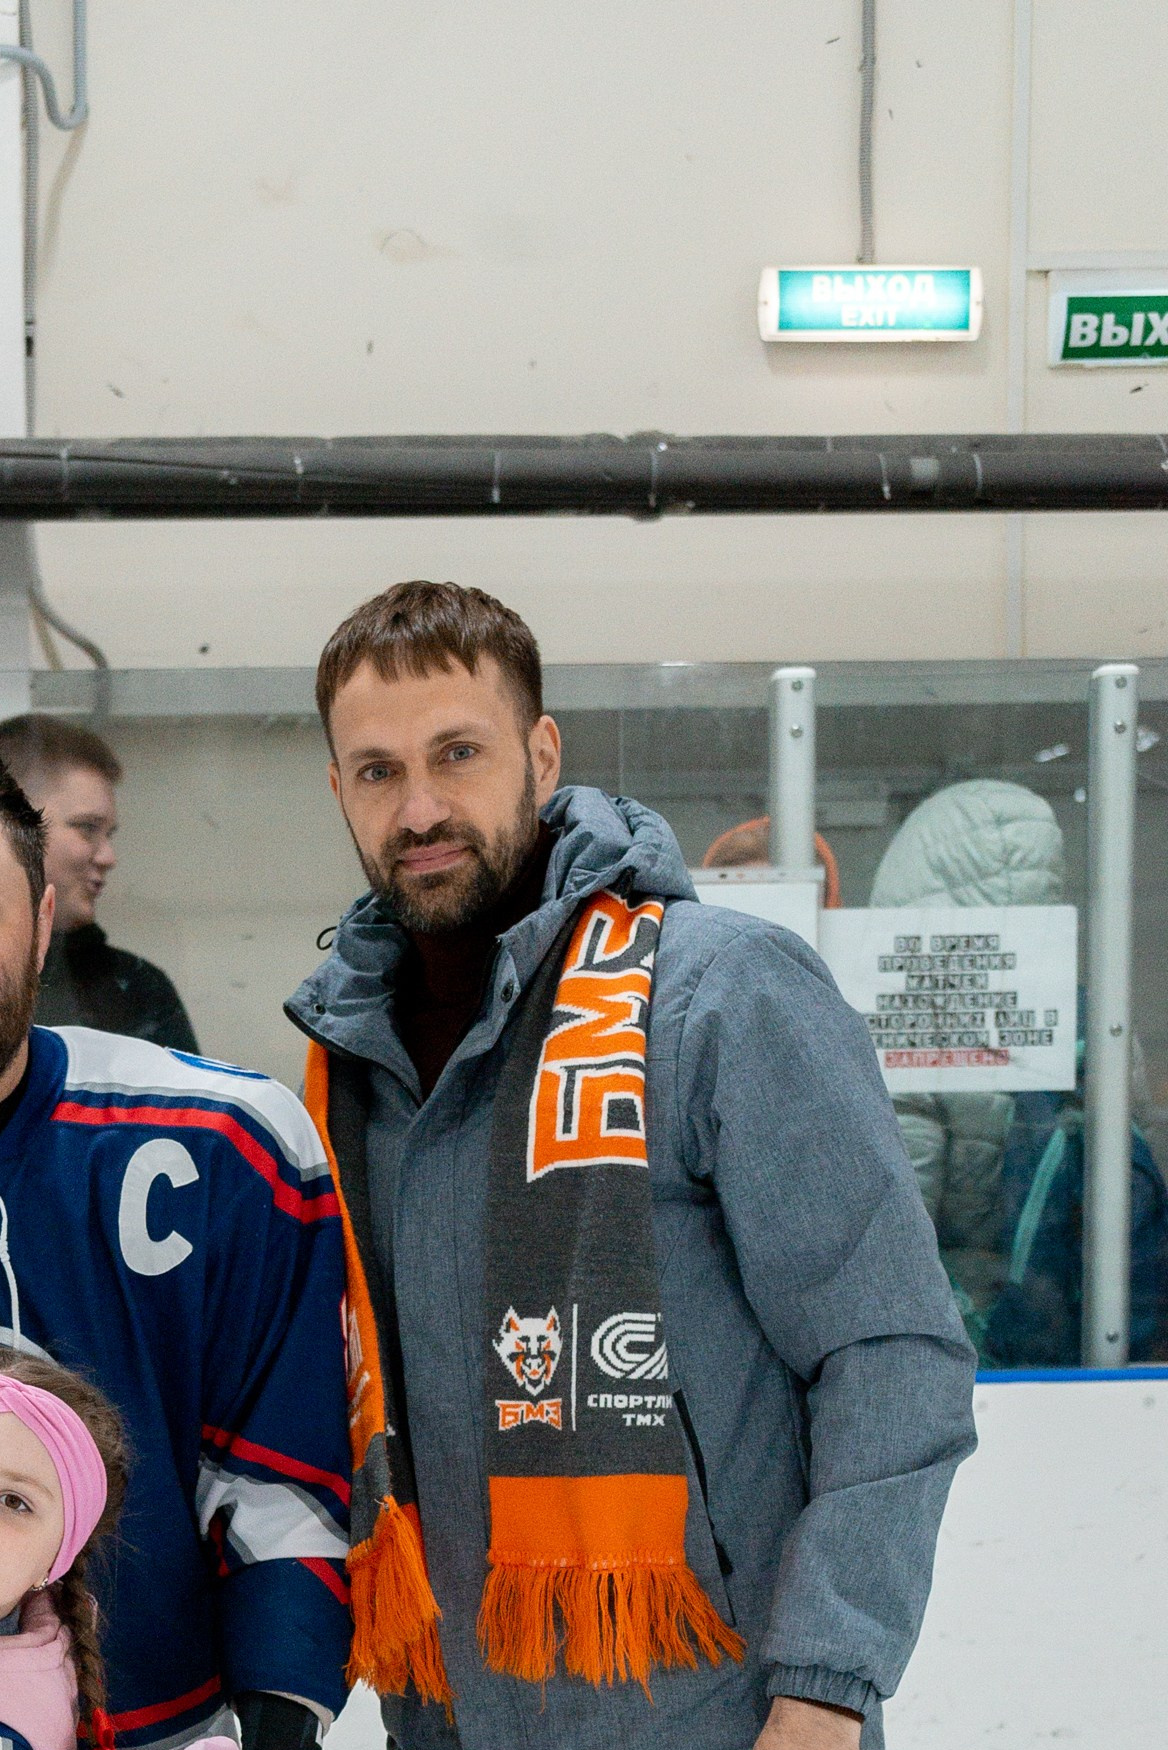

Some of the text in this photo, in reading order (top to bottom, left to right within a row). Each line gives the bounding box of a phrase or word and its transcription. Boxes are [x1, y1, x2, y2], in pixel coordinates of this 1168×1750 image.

[812, 274, 934, 305] ВЫХОД
[841, 304, 899, 327] EXIT
[1068, 312, 1168, 348] ВЫХ
[863, 1011, 985, 1031] СТОРОННИХ
[495, 1398, 562, 1431] БМЗ
[622, 1413, 666, 1427] ТМХ
